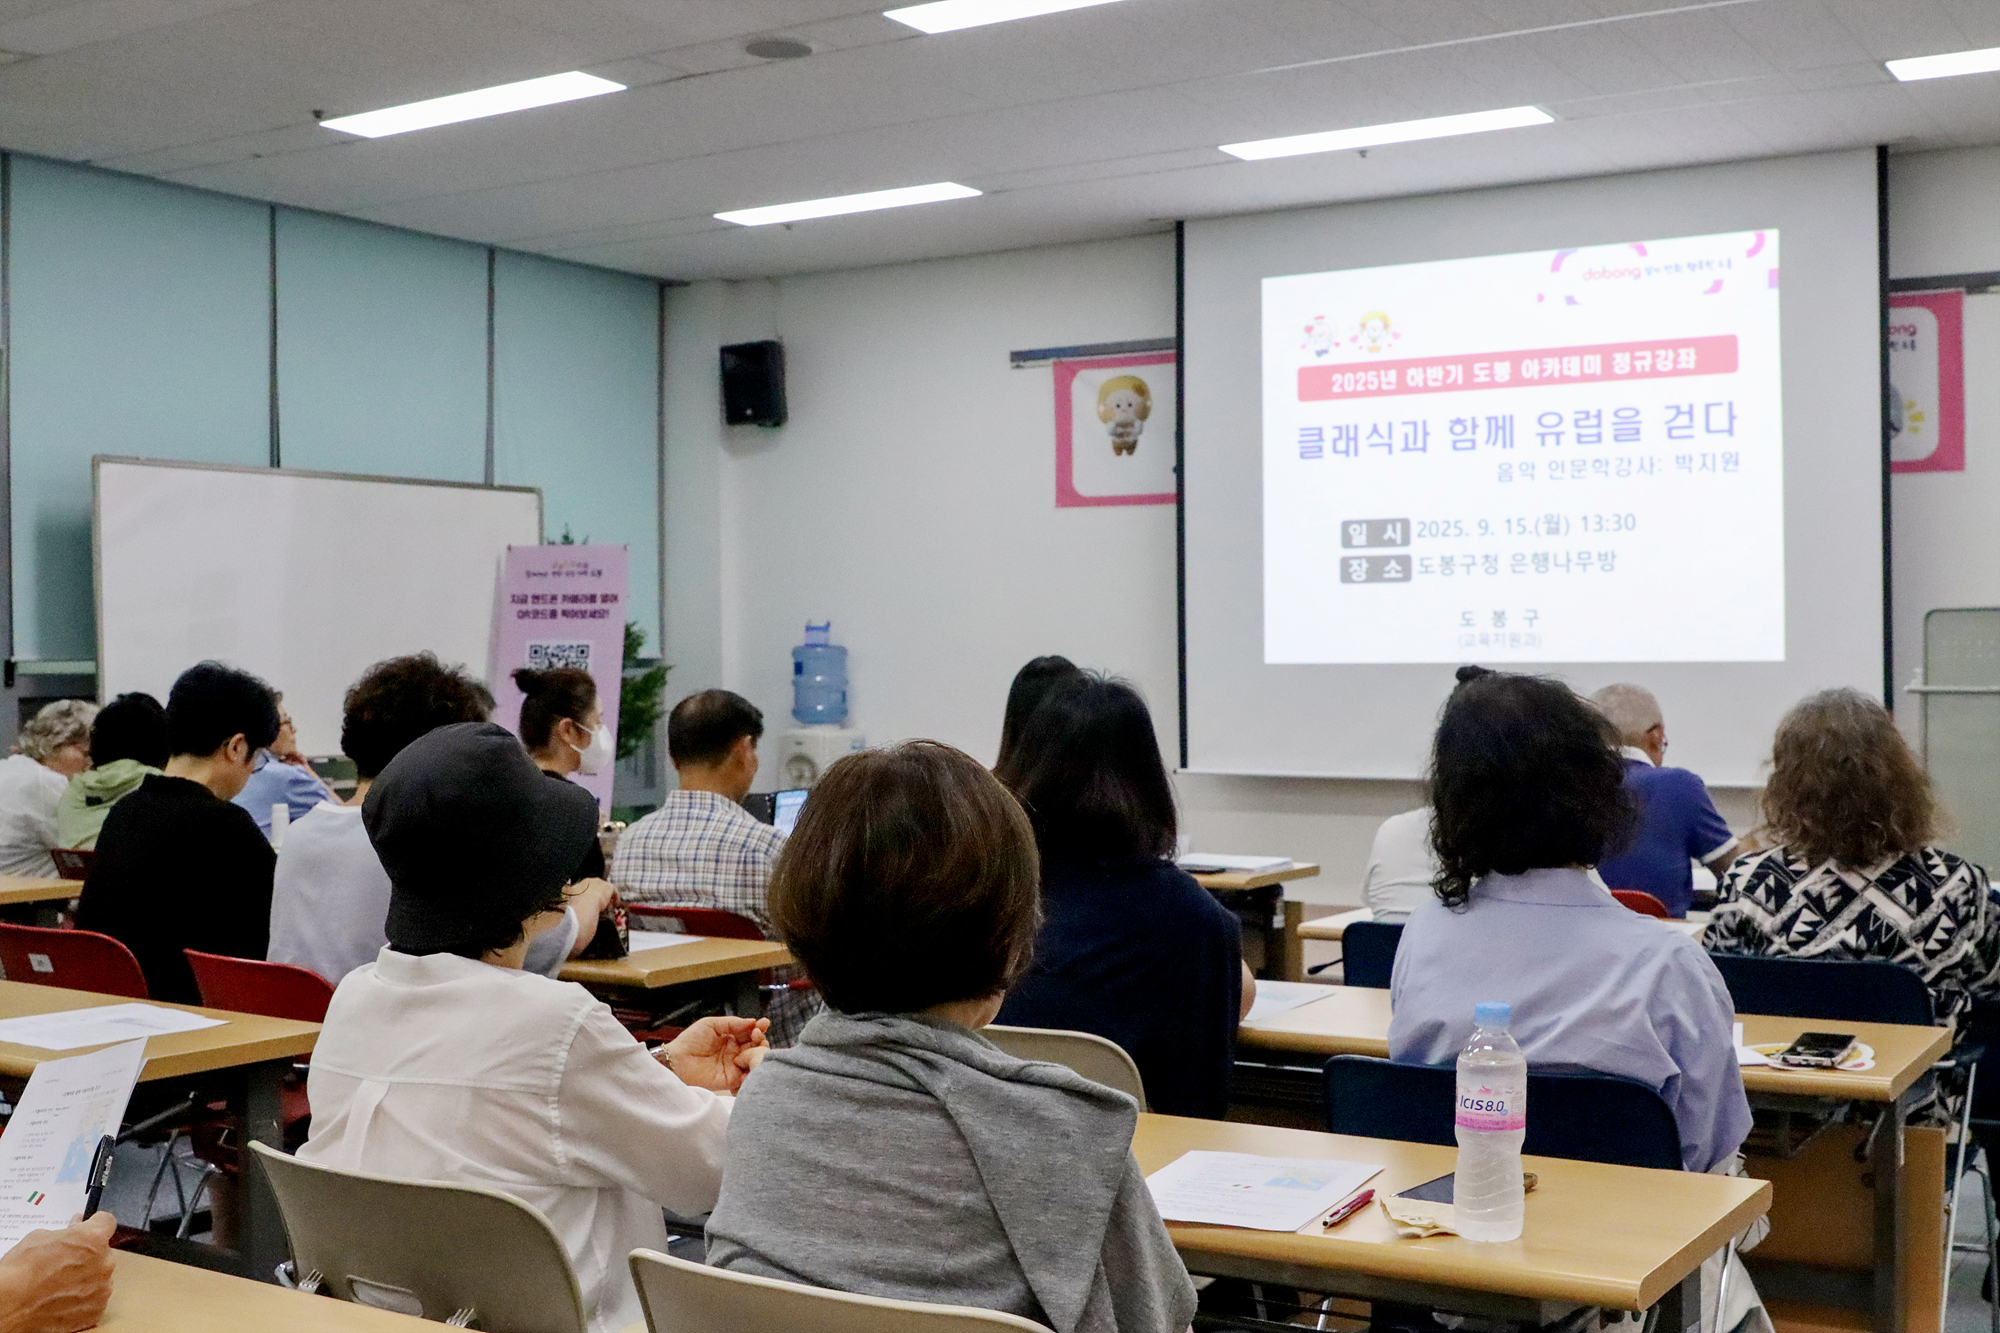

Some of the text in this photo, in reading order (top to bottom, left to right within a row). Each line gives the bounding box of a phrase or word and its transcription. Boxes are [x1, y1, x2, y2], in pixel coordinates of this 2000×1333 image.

[1583, 266, 1641, 281] dobong
[1331, 347, 1697, 393] 2025년 하반기 도봉 아카데미 정규강좌
[1298, 401, 1737, 459] 클래식과 함께 유럽을 걷다
[1498, 452, 1739, 482] 음악 인문학강사: 박지원
[1416, 513, 1636, 538] 2025. 9. 15.(월) 13:30
[1416, 550, 1617, 576] 도봉구청 은행나무방
[1457, 632, 1542, 649] (교육지원과)
